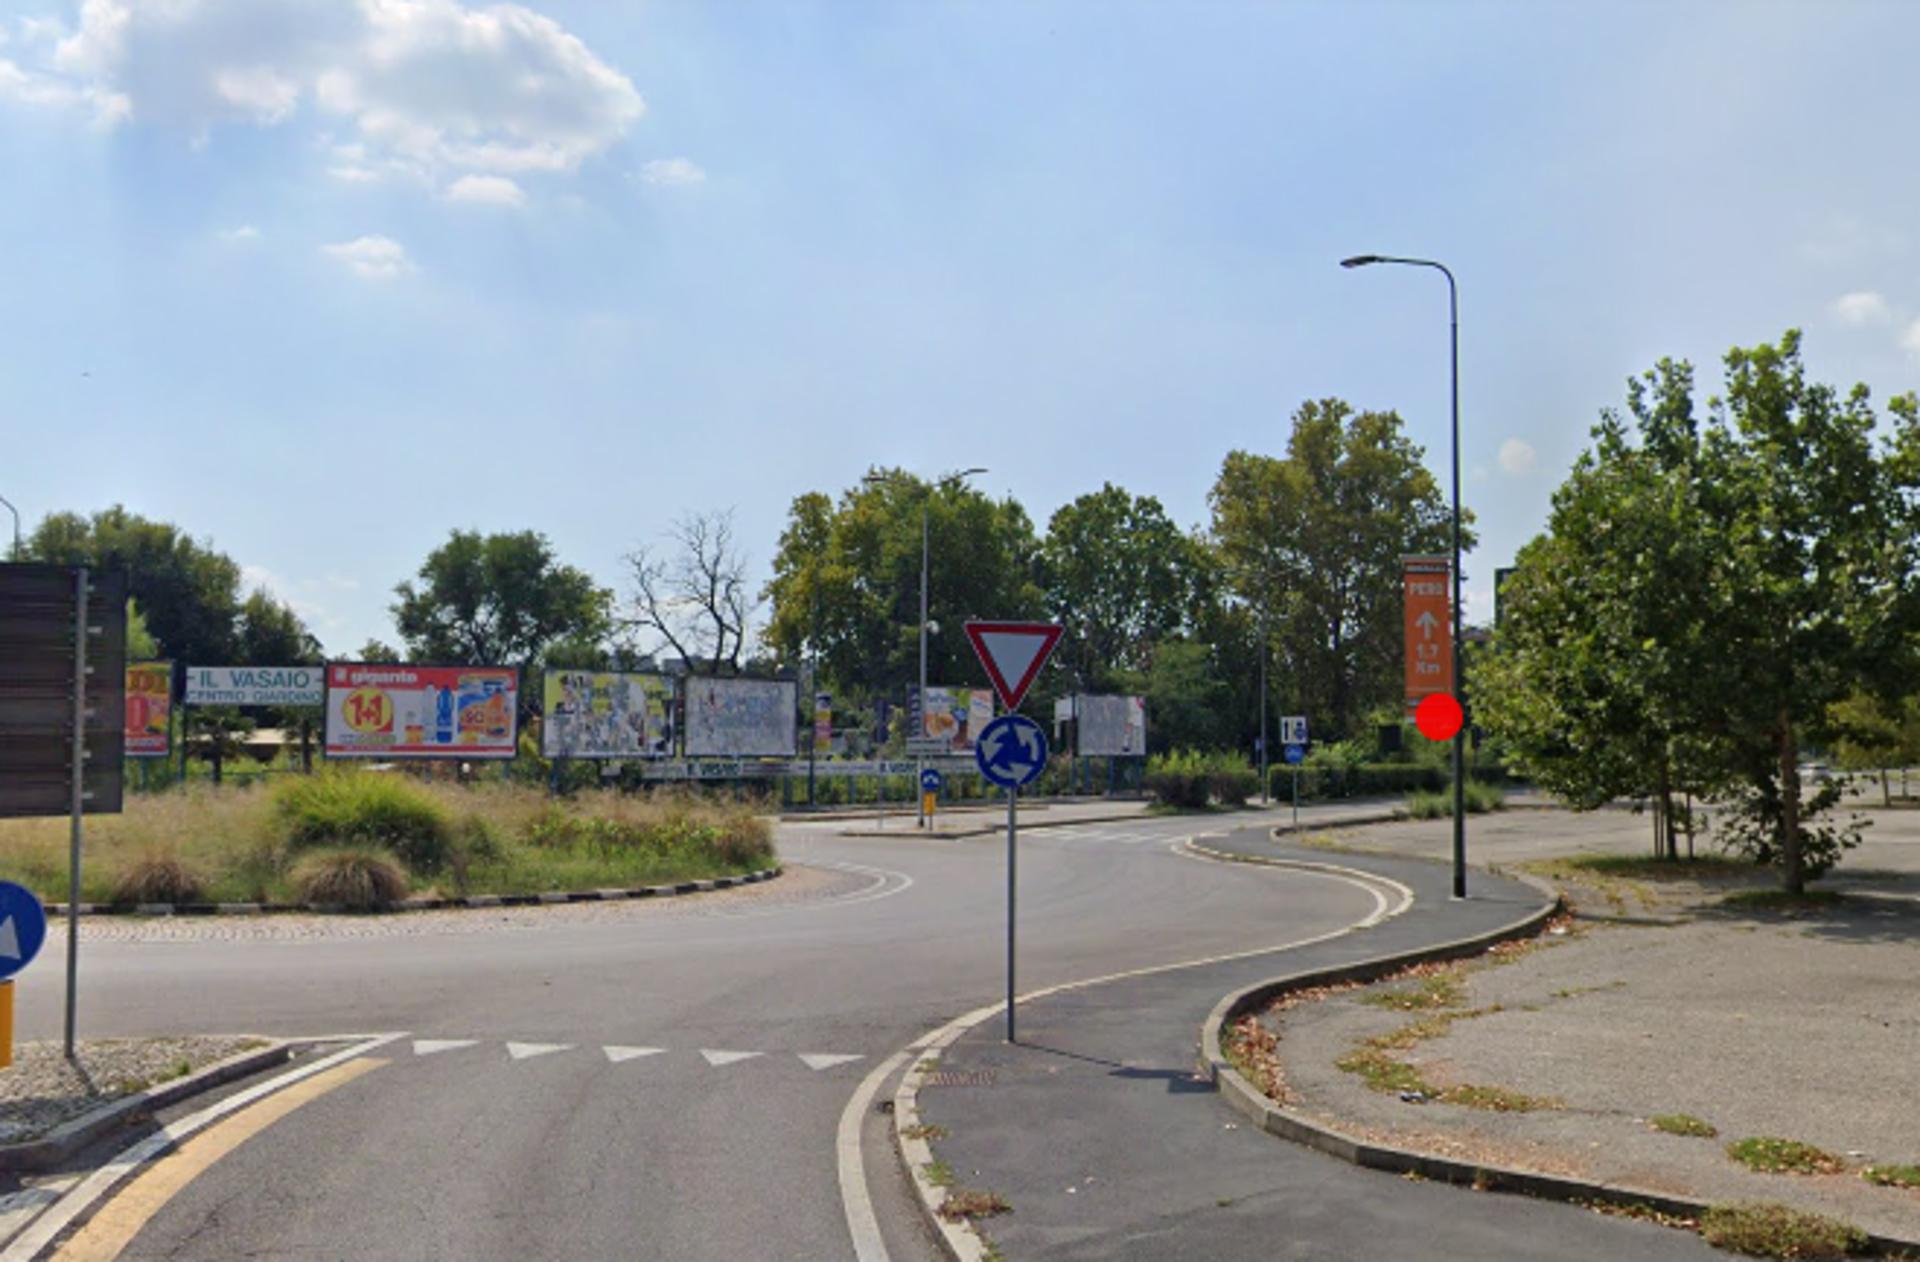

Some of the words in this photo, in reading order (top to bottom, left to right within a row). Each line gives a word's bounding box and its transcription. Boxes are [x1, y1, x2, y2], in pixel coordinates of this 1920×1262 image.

[200, 670, 218, 688] IL
[230, 670, 310, 688] VASAIO
[188, 690, 246, 702] CENTRO
[255, 691, 321, 703] GIARDINO
